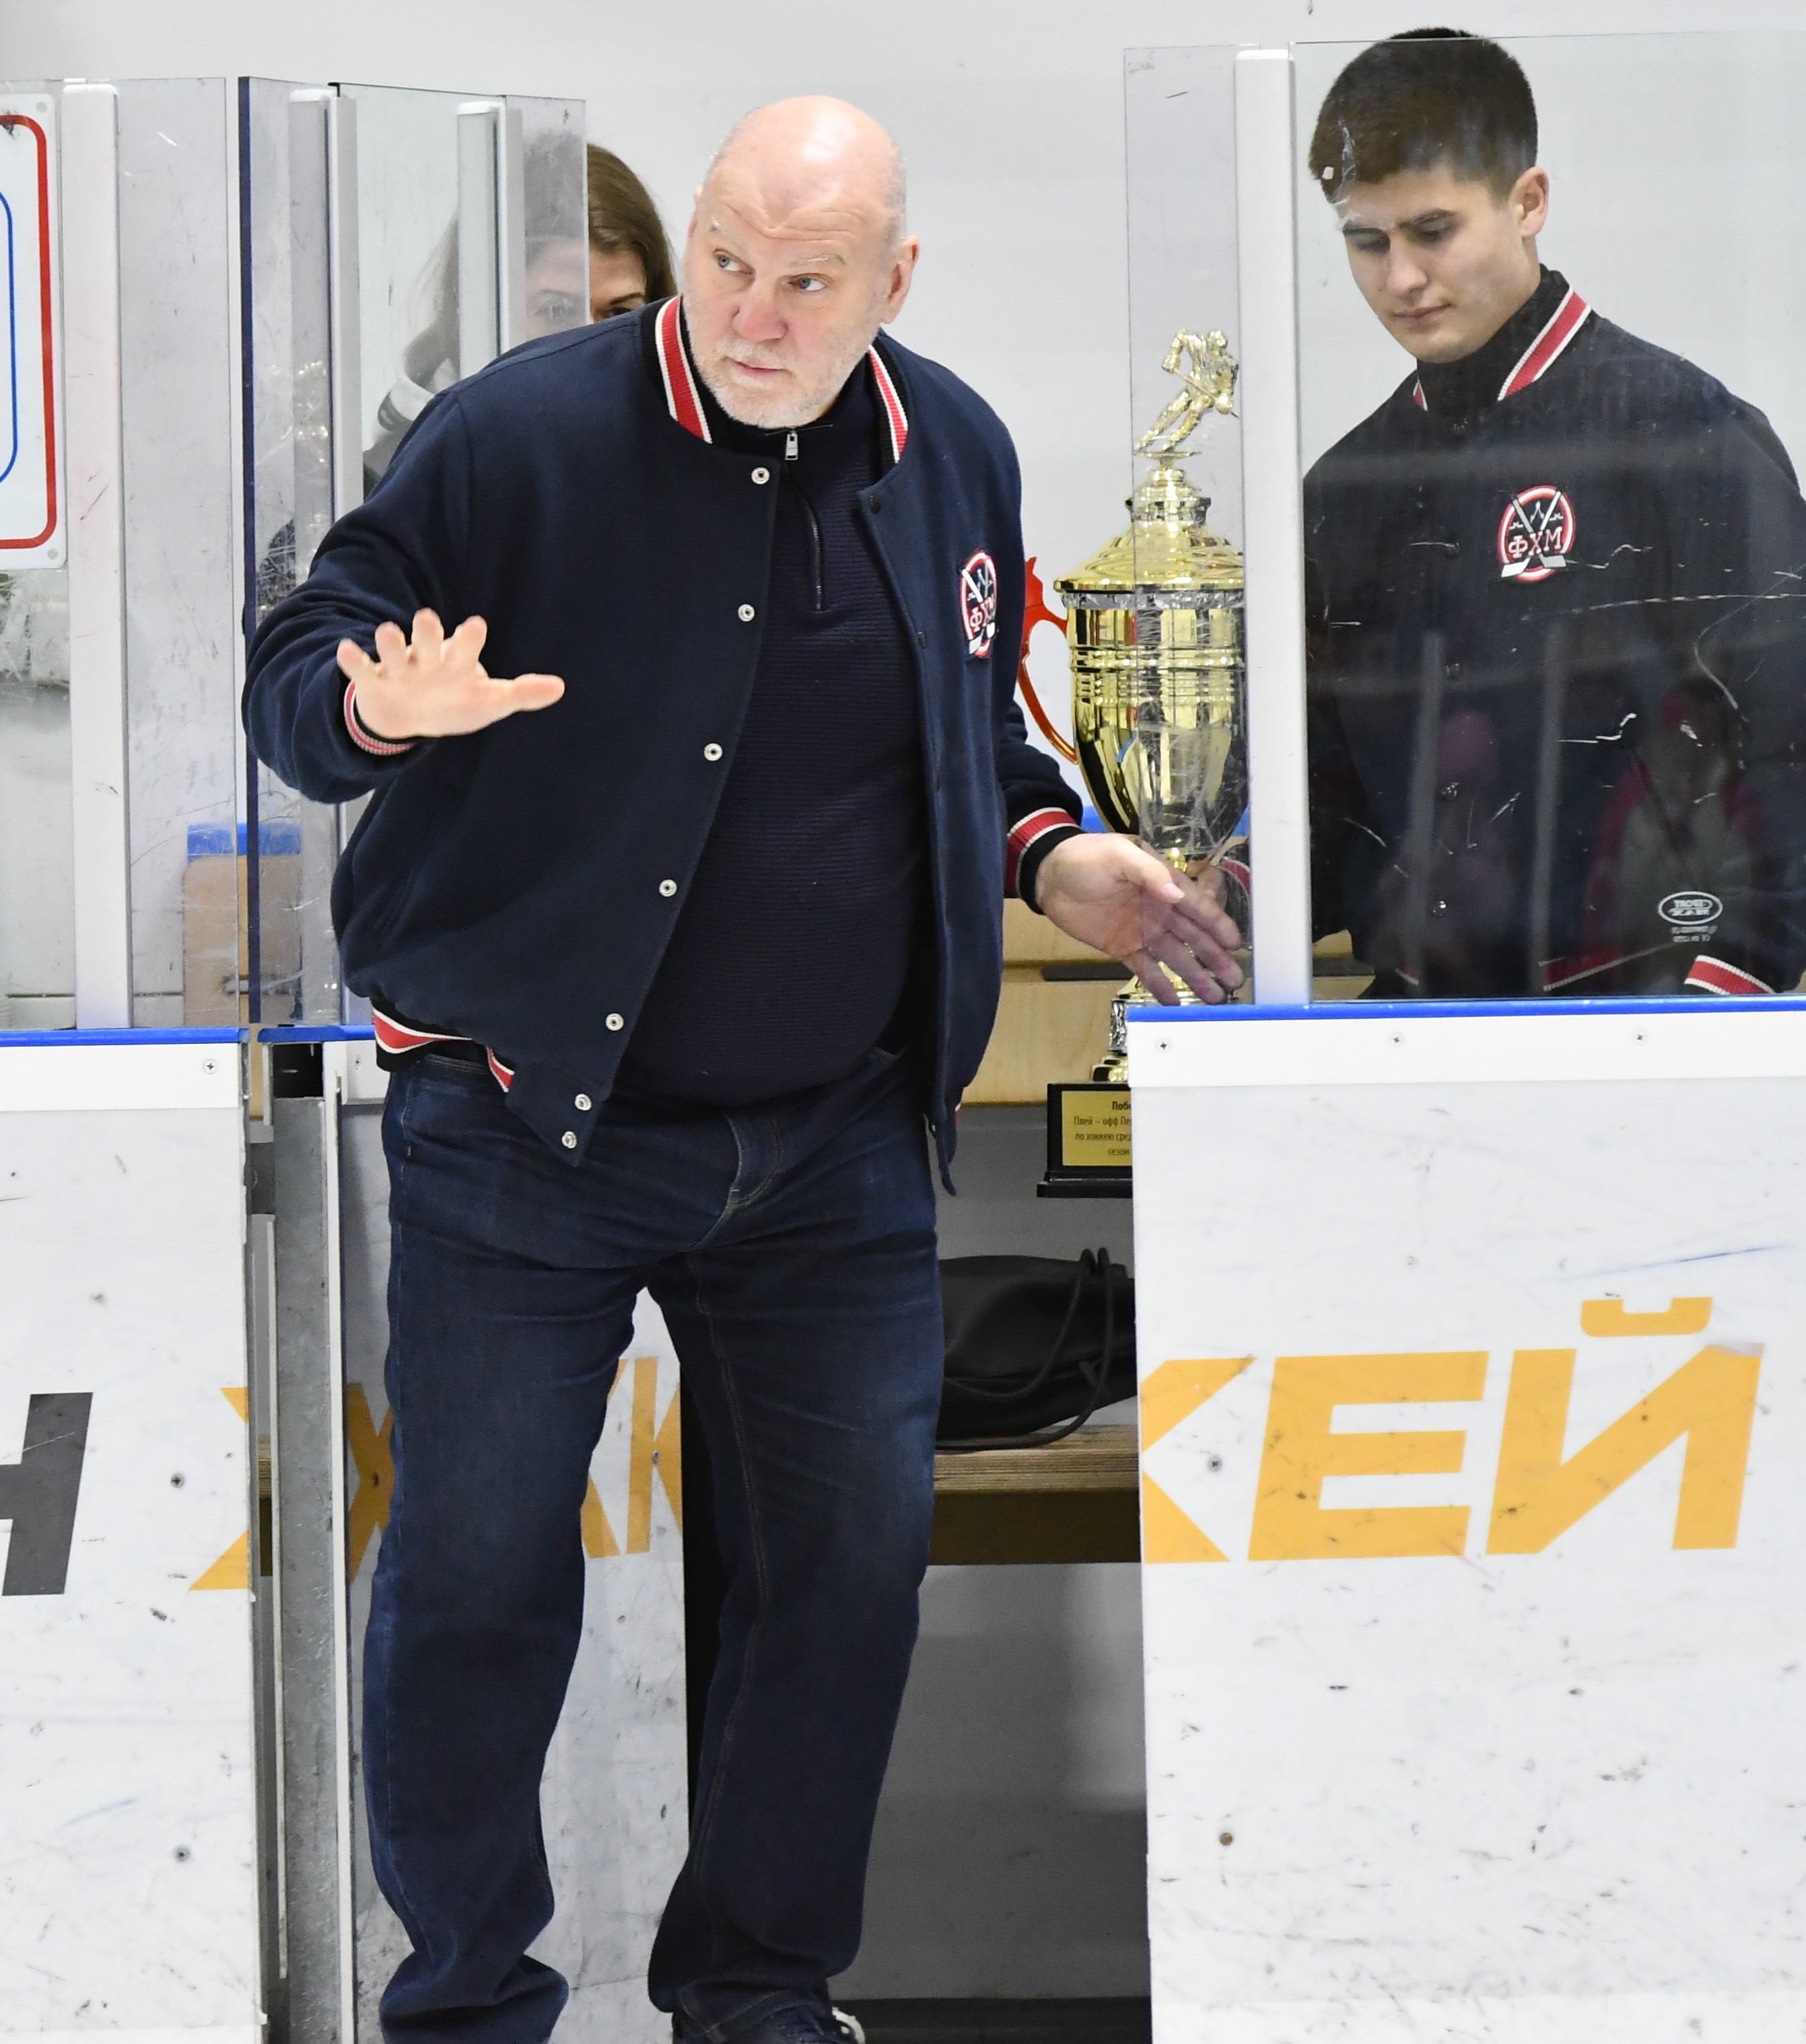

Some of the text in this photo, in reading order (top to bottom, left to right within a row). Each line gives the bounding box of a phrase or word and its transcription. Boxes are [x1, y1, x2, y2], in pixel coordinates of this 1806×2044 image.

[1508, 526, 1563, 559] ФХМ
[1074, 1116, 1093, 1125] Плей
[1103, 1117, 1119, 1127] офф
